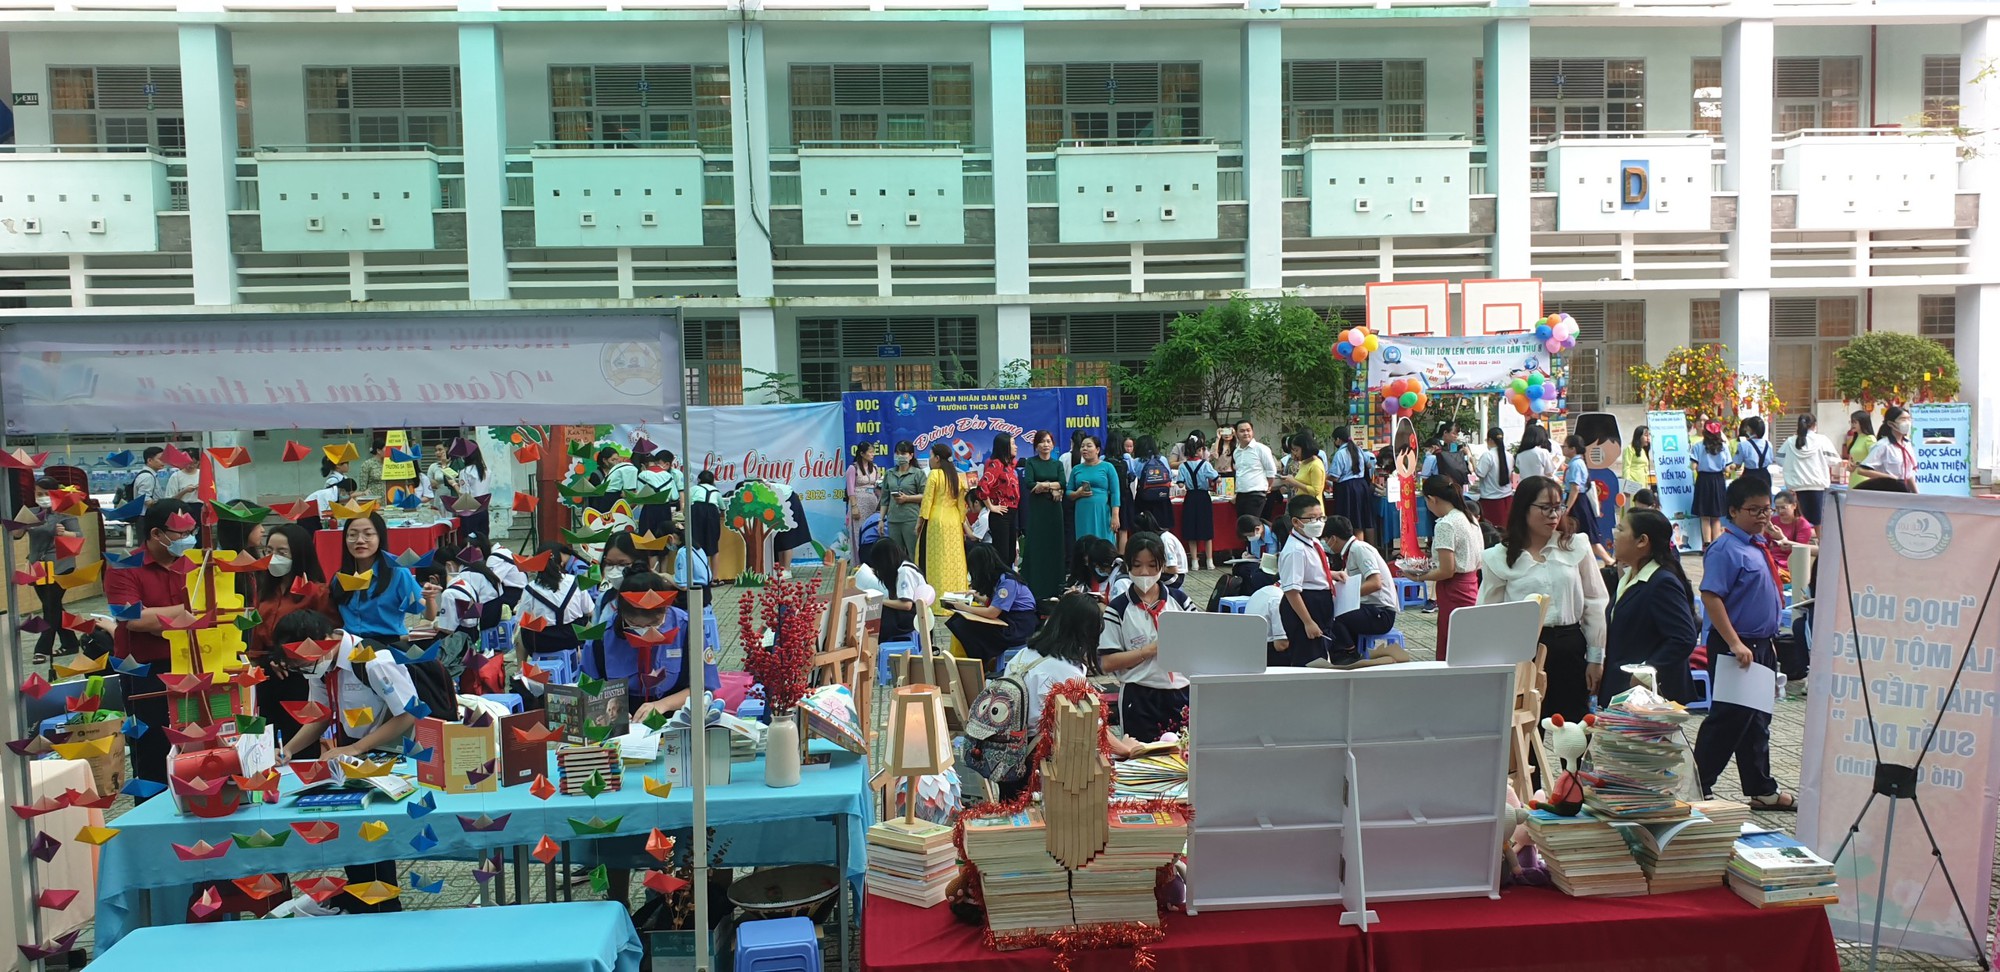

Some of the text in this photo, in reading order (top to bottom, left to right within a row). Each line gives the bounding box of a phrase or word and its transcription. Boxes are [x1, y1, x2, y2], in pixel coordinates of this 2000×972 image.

[1623, 167, 1647, 204] D
[855, 399, 880, 413] ĐỌC
[1076, 394, 1088, 406] ĐI
[855, 419, 882, 435] MỘT
[1065, 415, 1100, 428] MUÔN
[913, 424, 955, 450] Đường
[955, 414, 987, 432] Đến
[851, 440, 889, 457] QỂN
[1918, 447, 1962, 458] ĐỌC SÁCH
[743, 450, 794, 485] Cùng
[799, 447, 844, 478] Sách
[1658, 456, 1673, 465] SÁCH
[1941, 461, 1967, 471] THIỆN
[1661, 469, 1687, 481] KIẾN TẠO
[1915, 473, 1966, 483] NHÂN CÁCH
[806, 489, 826, 501] 2022
[1682, 485, 1692, 494] LAI
